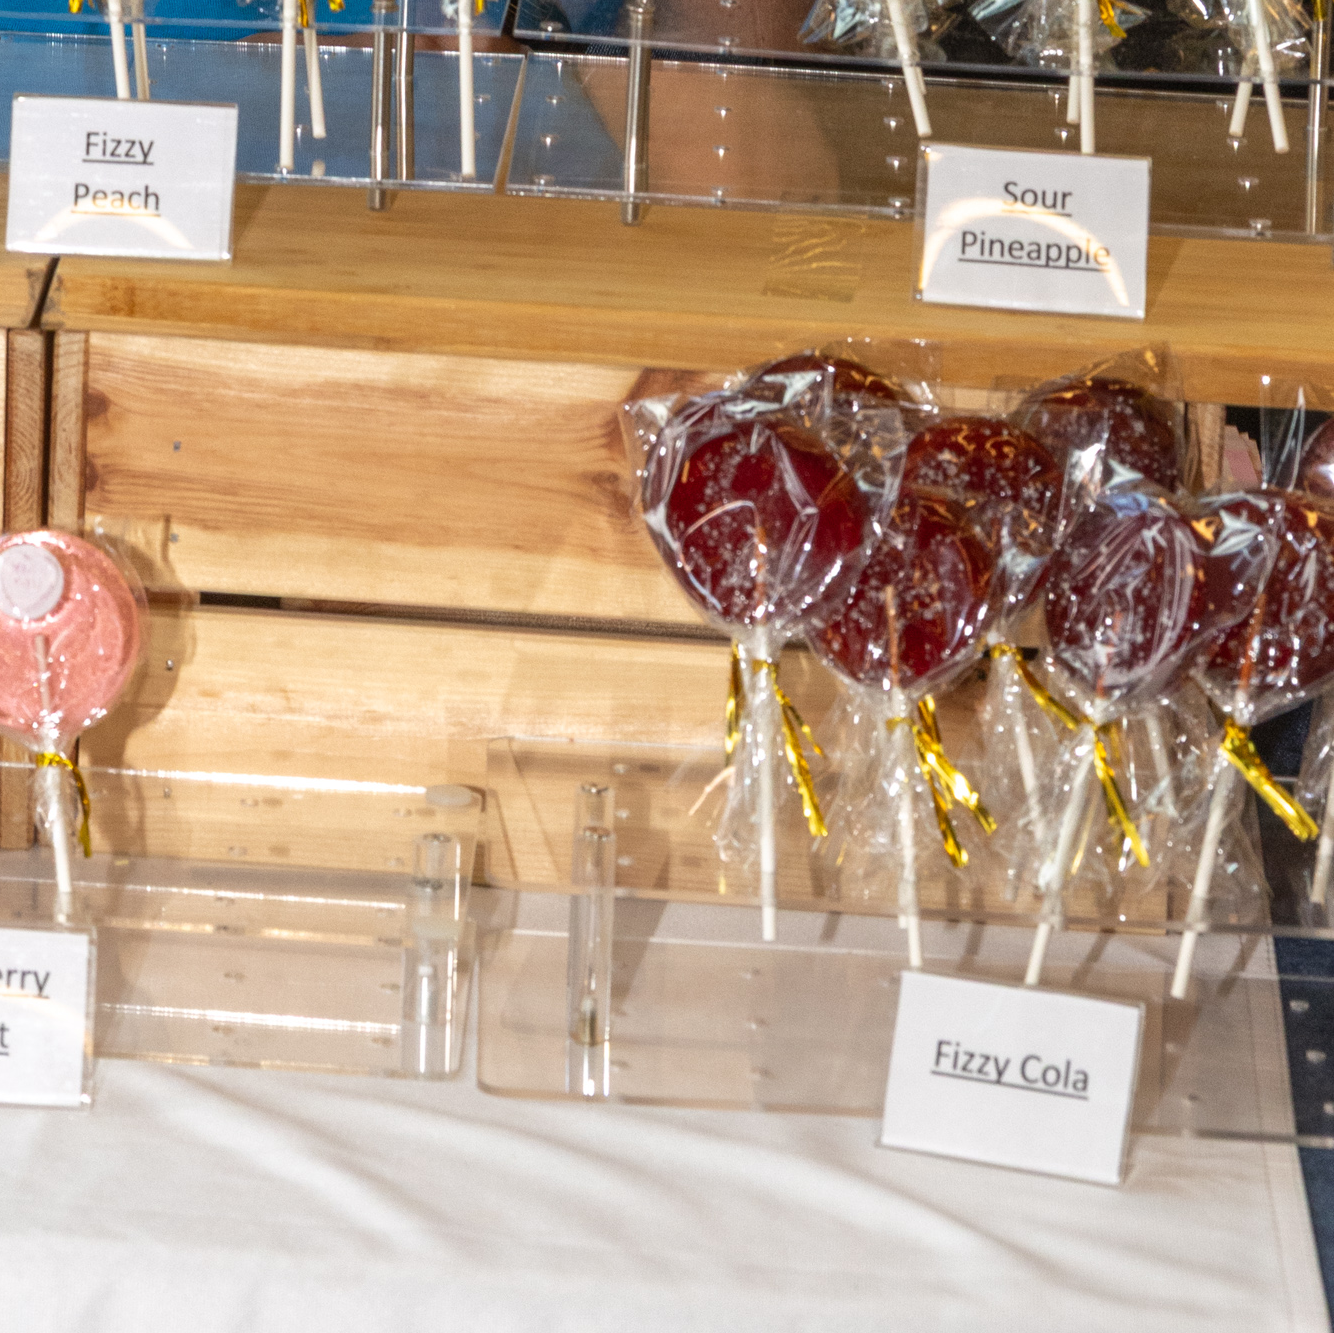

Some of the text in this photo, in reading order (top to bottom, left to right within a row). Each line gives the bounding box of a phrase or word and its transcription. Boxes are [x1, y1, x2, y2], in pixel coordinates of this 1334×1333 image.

[84, 131, 155, 165] Fizzy
[73, 183, 160, 212] Peach
[1002, 181, 1073, 212] Sour
[960, 230, 1112, 269] Pineapple
[933, 1039, 1090, 1092] Fizzy Cola
